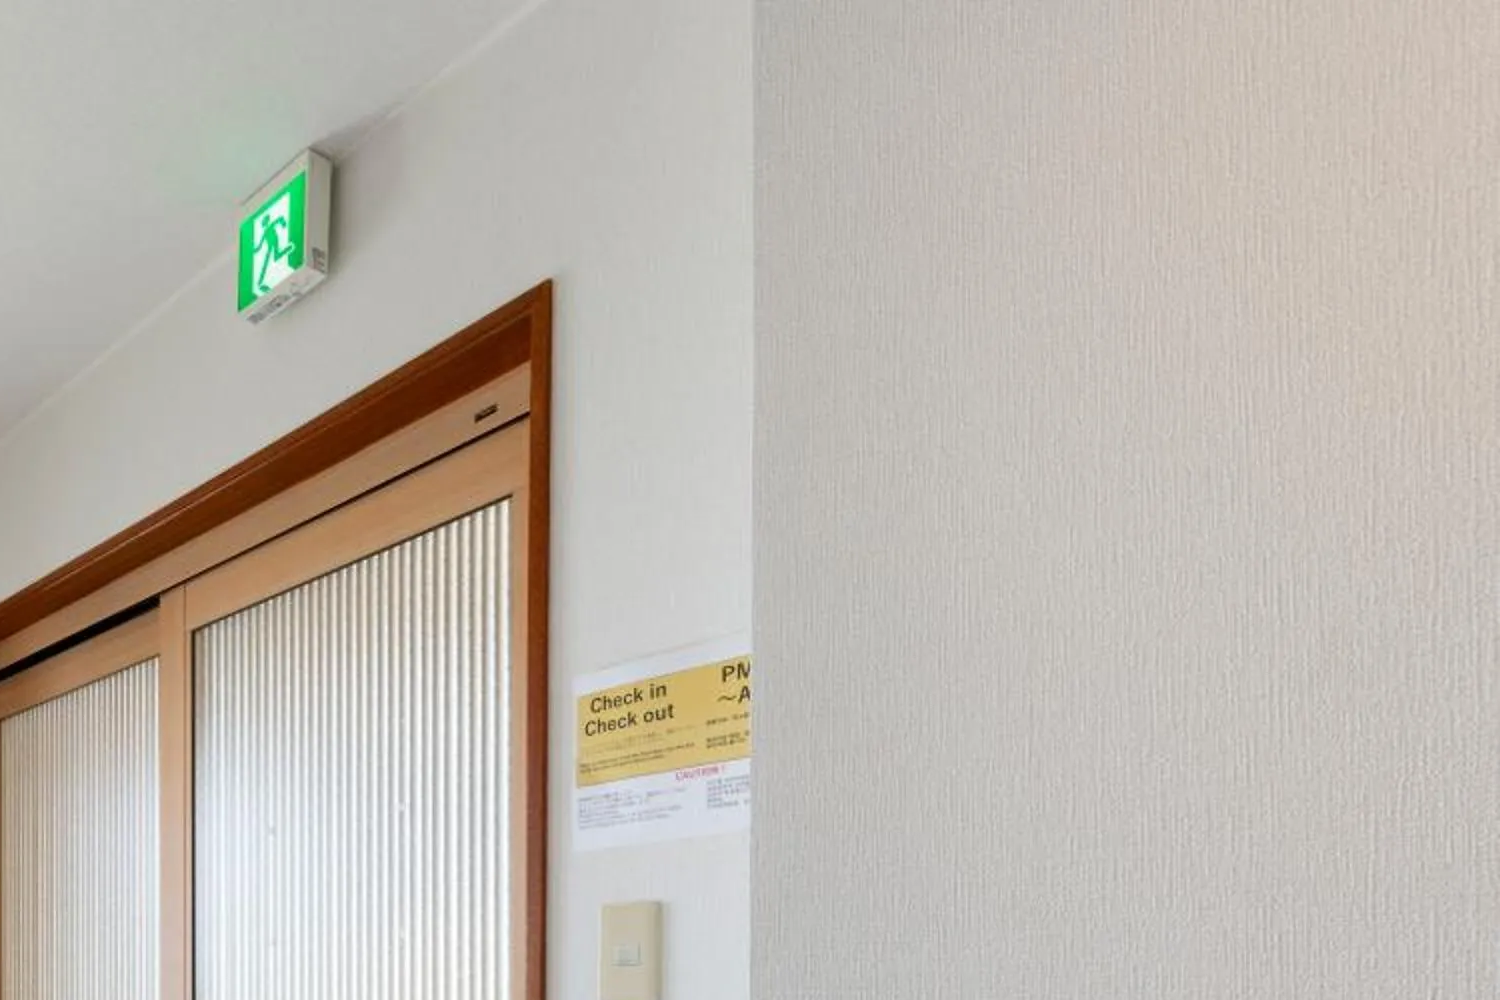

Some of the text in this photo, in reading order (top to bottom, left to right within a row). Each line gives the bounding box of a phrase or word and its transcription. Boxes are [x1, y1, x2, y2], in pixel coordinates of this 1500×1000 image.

[590, 683, 668, 713] Check in
[584, 704, 675, 737] Check out
